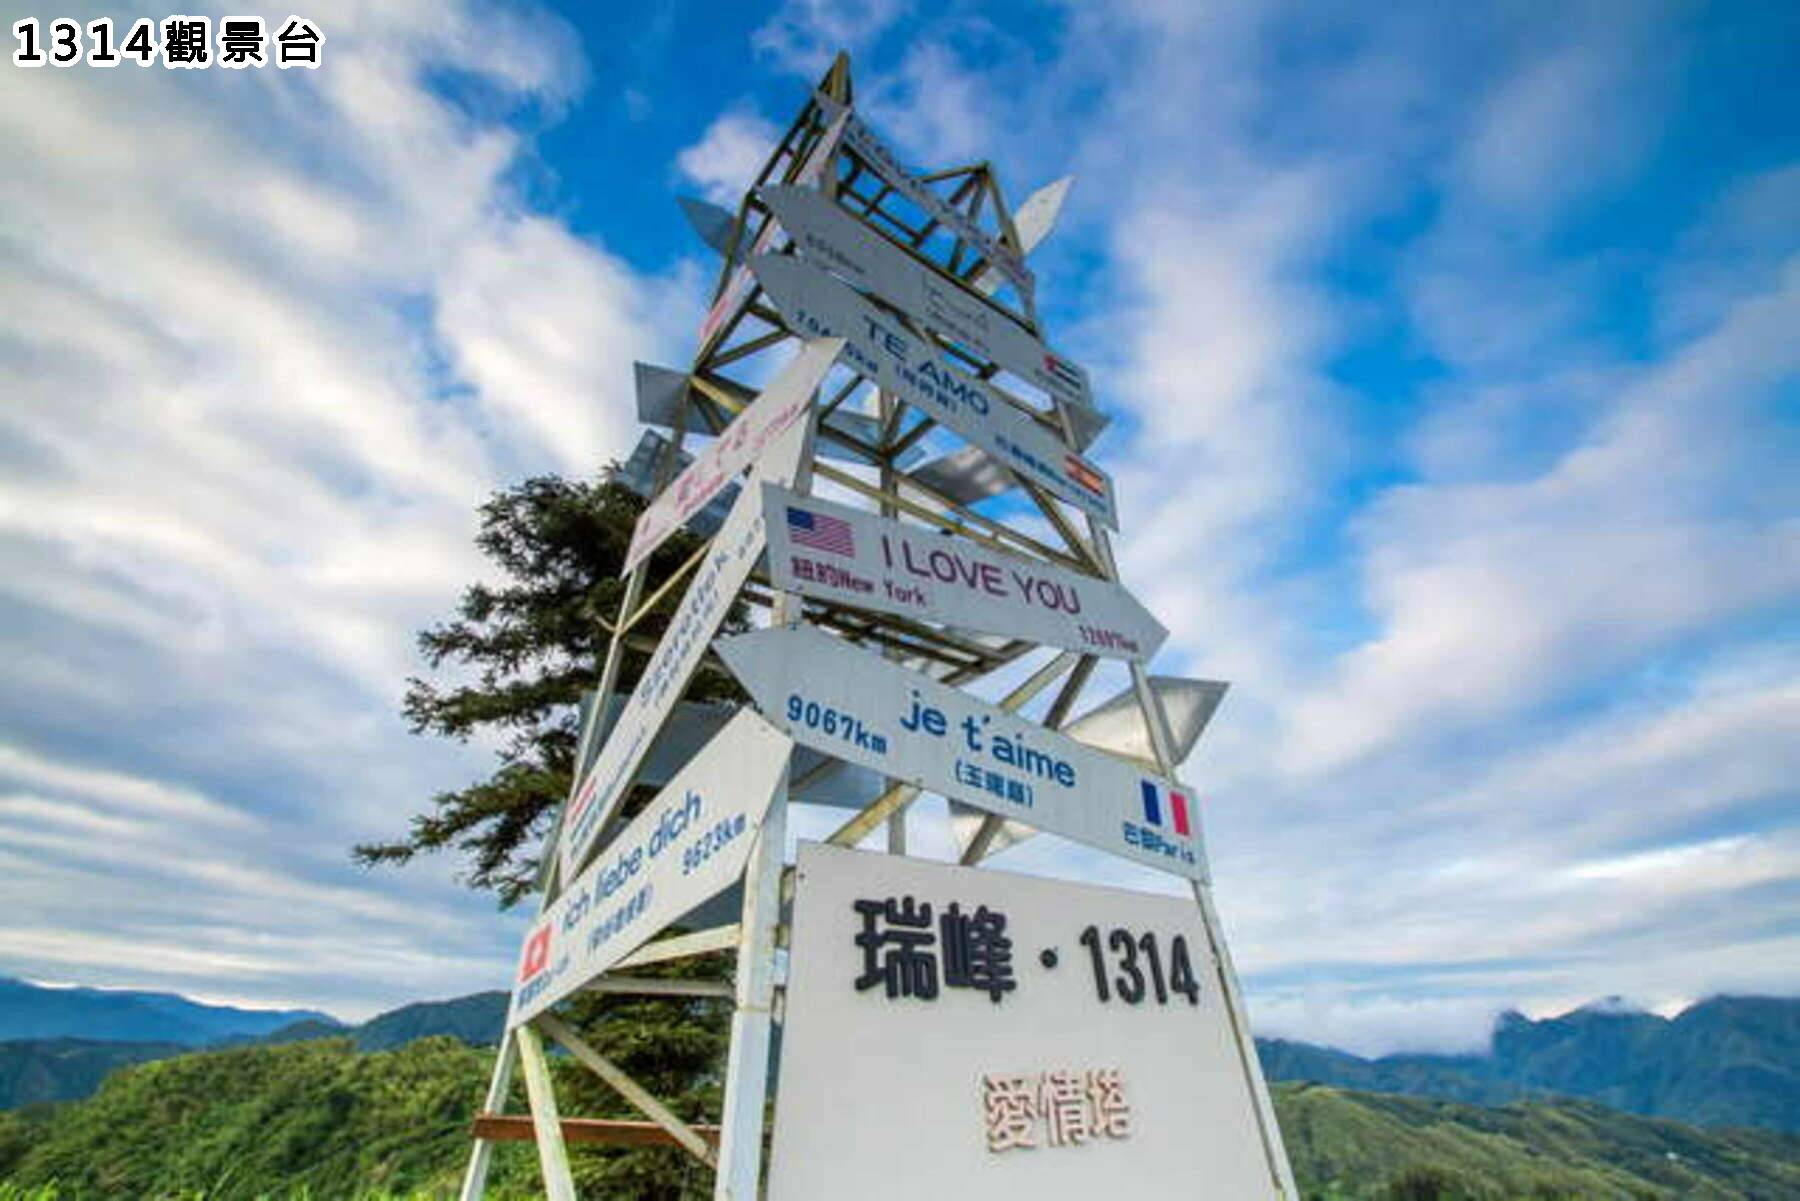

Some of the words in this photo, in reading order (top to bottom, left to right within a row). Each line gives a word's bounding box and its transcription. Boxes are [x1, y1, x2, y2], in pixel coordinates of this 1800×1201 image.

[863, 315, 907, 362] TE
[918, 360, 990, 417] AMO
[881, 535, 894, 568] I
[903, 541, 1009, 598] LOVE
[1011, 571, 1082, 616] YOU
[882, 577, 928, 608] York
[786, 694, 889, 756] 9067km
[899, 690, 949, 738] je
[960, 714, 1077, 791] t'aime
[649, 788, 702, 859] dich
[853, 896, 1018, 1005] 瑞峰
[1080, 925, 1200, 1006] 1314
[982, 1067, 1132, 1153] 愛情塔
